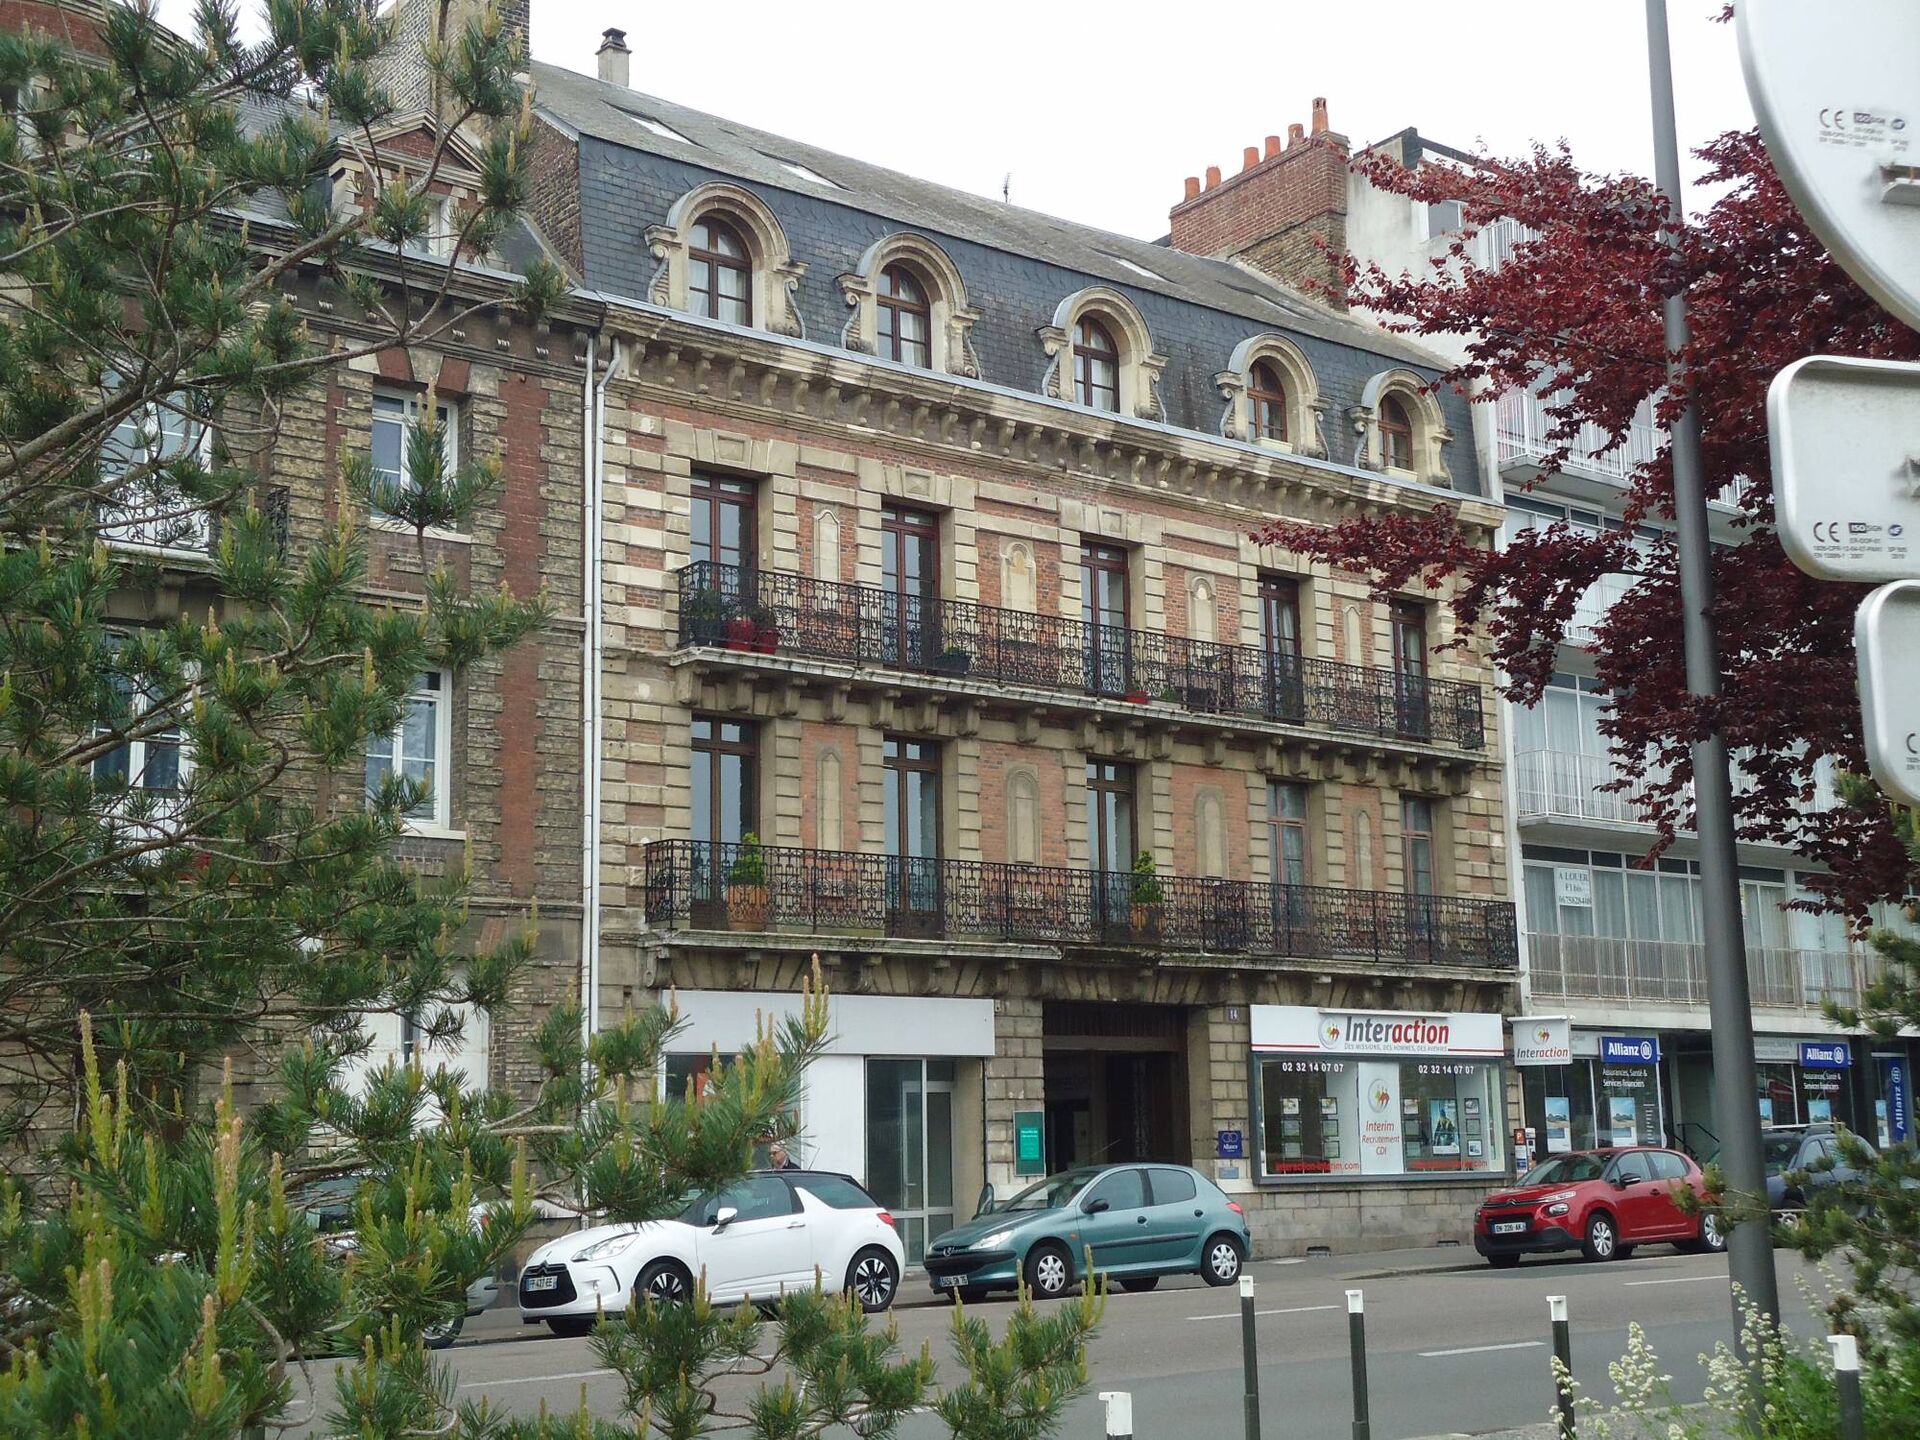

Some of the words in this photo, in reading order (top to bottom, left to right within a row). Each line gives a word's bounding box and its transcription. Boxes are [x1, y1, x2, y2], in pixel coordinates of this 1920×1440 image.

[1813, 522, 1840, 542] CE
[1345, 1016, 1450, 1044] Interaction
[1517, 1047, 1569, 1059] Interaction
[1608, 1043, 1640, 1056] Allianz
[1806, 1048, 1833, 1061] Allianz
[1282, 1063, 1293, 1072] 02
[1296, 1063, 1306, 1072] 32
[1309, 1063, 1319, 1072] 14
[1321, 1063, 1331, 1072] 07
[1334, 1064, 1344, 1073] 07
[1418, 1065, 1428, 1073] 02
[1430, 1065, 1440, 1074] 32
[1443, 1065, 1452, 1074] 14
[1453, 1065, 1463, 1074] 07
[1465, 1065, 1474, 1074] 07
[1894, 1087, 1904, 1131] Allianz
[1362, 1135, 1400, 1143] Recrutement
[1376, 1146, 1387, 1155] CDI
